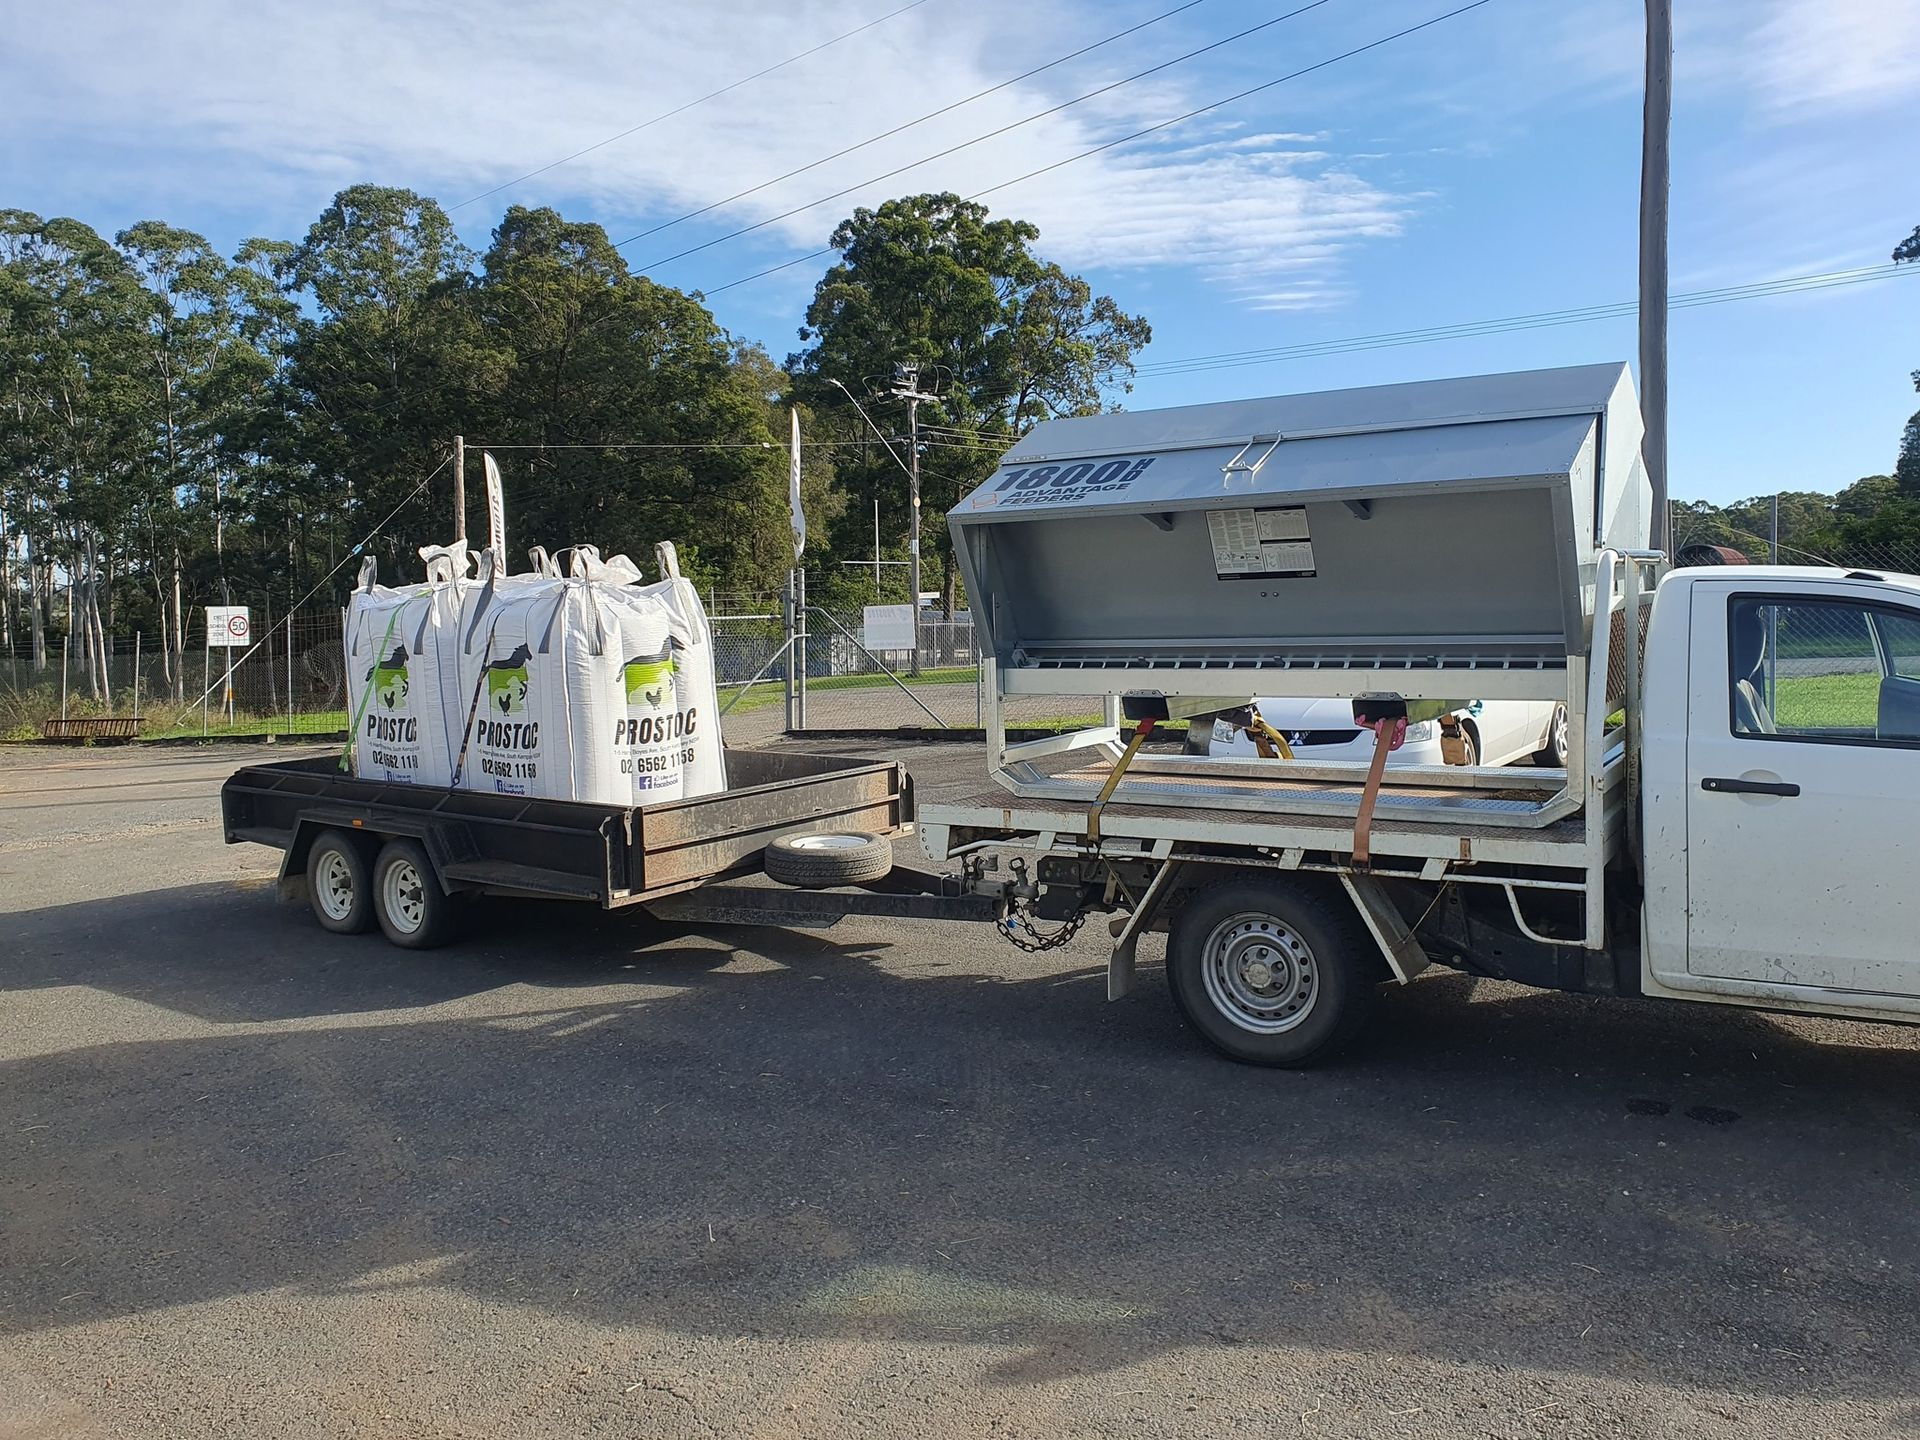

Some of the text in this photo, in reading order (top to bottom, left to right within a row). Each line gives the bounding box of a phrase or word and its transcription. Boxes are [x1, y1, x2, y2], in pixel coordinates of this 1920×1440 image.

[995, 460, 1132, 492] 1800
[1000, 493, 1087, 505] FEEDERS
[1008, 483, 1131, 498] ADVANTAGE
[232, 621, 246, 631] 50
[477, 719, 539, 749] PROSTOC
[614, 707, 697, 746] PROSTOC
[372, 750, 384, 765] 02
[620, 747, 695, 774] 02 6562 1158
[482, 758, 493, 774] 02
[515, 762, 537, 779] 1158
[653, 778, 678, 789] facebook
